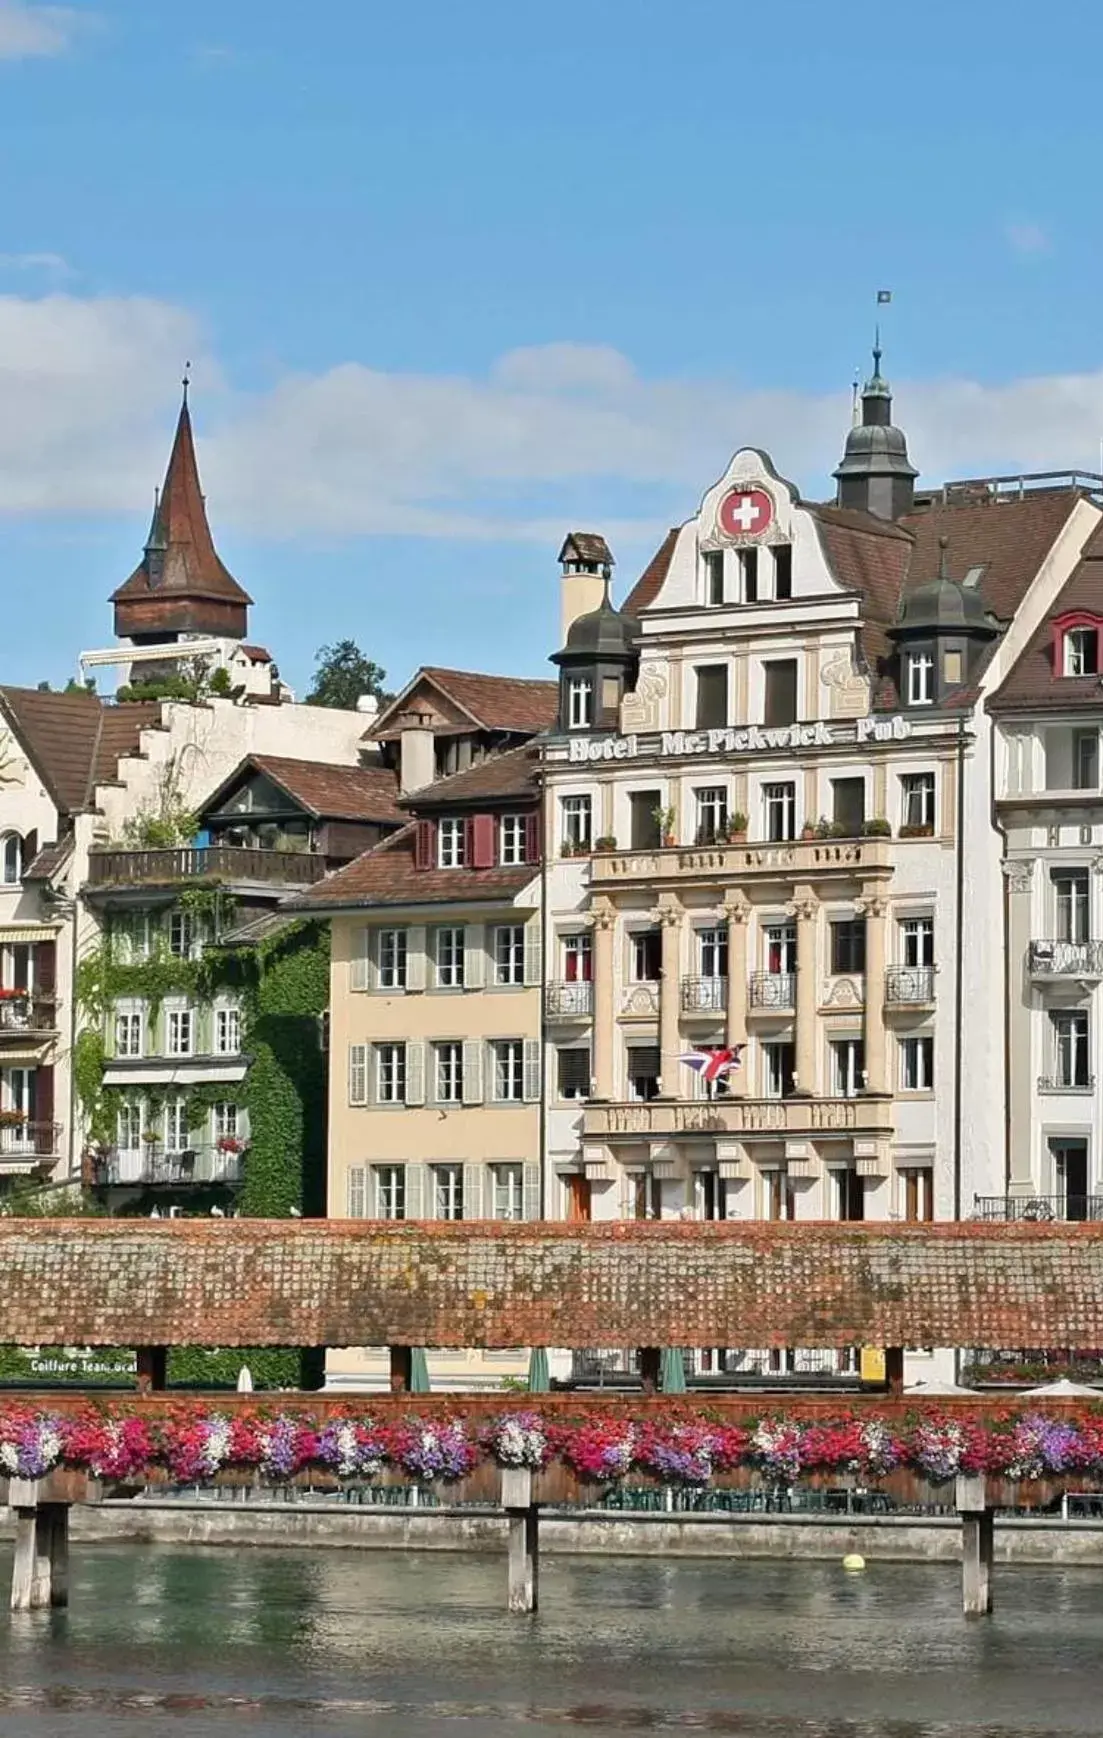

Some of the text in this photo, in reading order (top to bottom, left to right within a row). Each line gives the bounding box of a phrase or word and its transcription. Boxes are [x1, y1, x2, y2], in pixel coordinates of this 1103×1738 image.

[568, 734, 638, 762] Hotel
[707, 721, 834, 752] Pickwick
[856, 715, 912, 742] Pub
